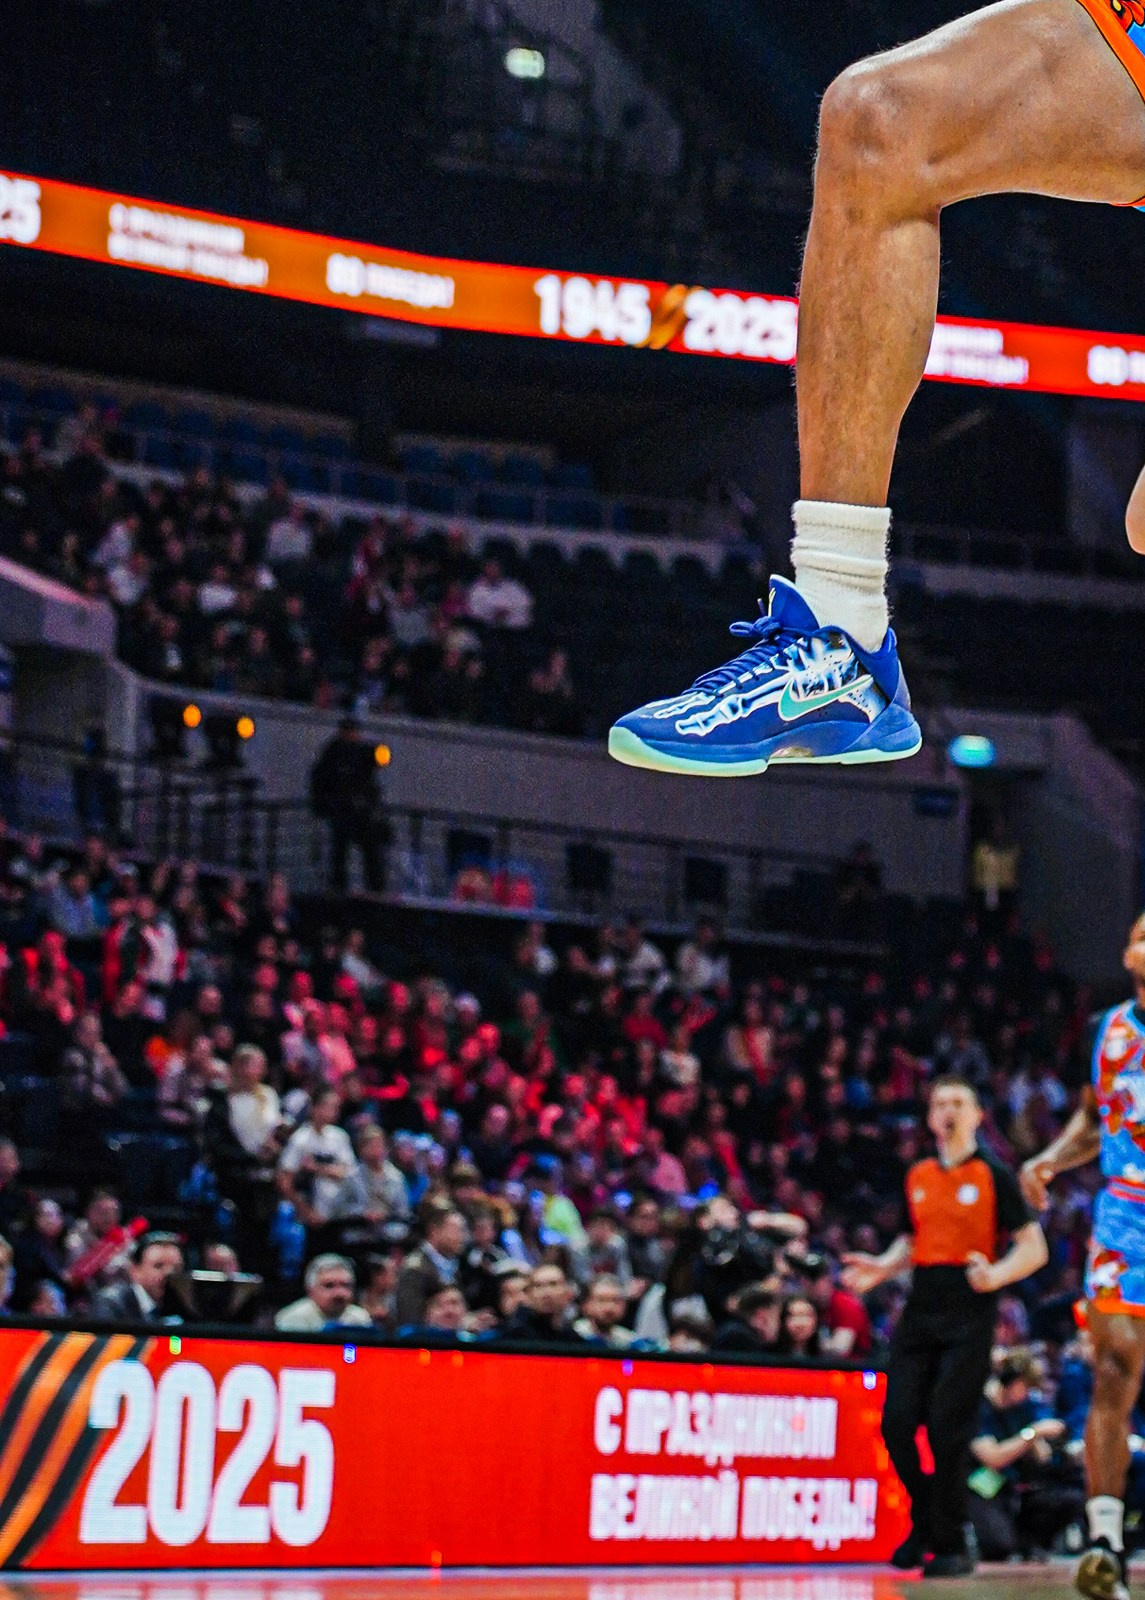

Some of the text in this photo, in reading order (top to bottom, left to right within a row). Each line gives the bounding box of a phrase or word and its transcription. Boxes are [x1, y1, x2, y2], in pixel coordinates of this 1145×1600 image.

[534, 274, 652, 346] 1945
[78, 1359, 336, 1547] 2025
[594, 1386, 838, 1467] С ПРАЗДНИКОМ
[589, 1468, 739, 1541] ВЕЛИКОЙ
